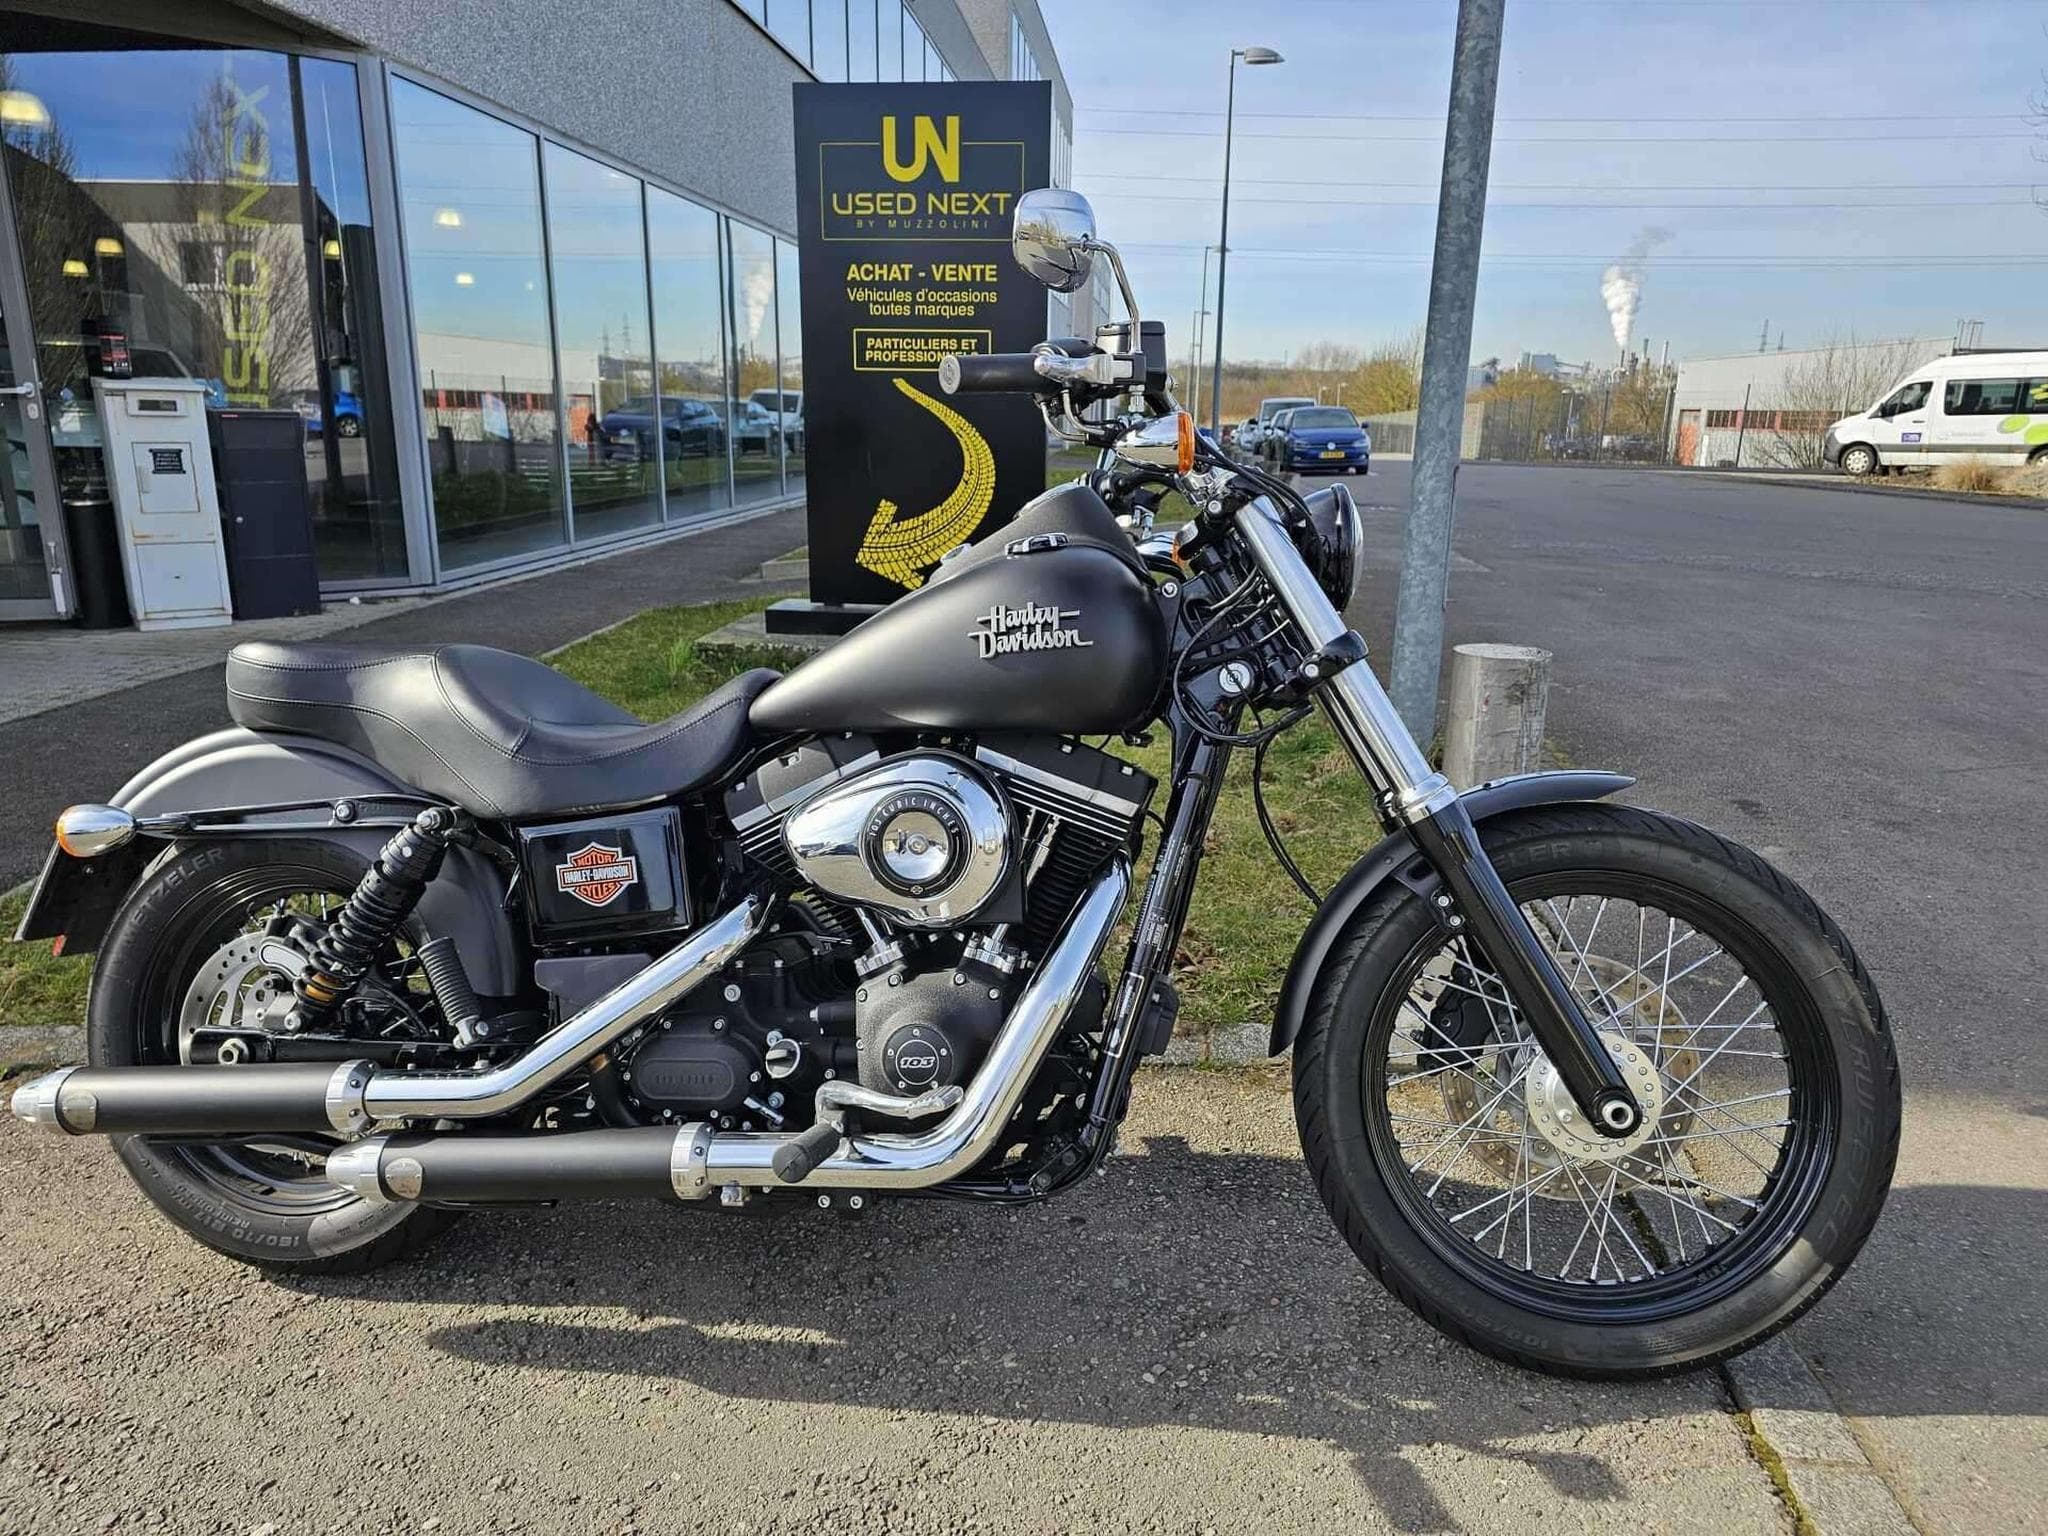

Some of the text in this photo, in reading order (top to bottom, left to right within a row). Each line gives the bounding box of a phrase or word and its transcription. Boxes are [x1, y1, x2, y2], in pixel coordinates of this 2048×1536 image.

[882, 115, 961, 183] UN
[832, 192, 1012, 215] USED NEXT
[856, 219, 989, 229] BY MUZZOLINI
[847, 263, 913, 281] ACHAT
[931, 264, 998, 282] VENTE
[847, 287, 998, 303] Véhicules d'occasions
[869, 302, 975, 319] toutes marques
[866, 337, 978, 350] PARTICULIERS ET
[865, 350, 979, 362] PROFESSION
[977, 602, 1080, 632] Harley
[968, 624, 1094, 659] Davidson
[882, 797, 916, 816] CUBIC
[923, 799, 959, 834] INCHES
[576, 852, 613, 866] MOTOR
[563, 865, 629, 884] HARLEY-DAVIDSON
[580, 882, 615, 899] CYCLES
